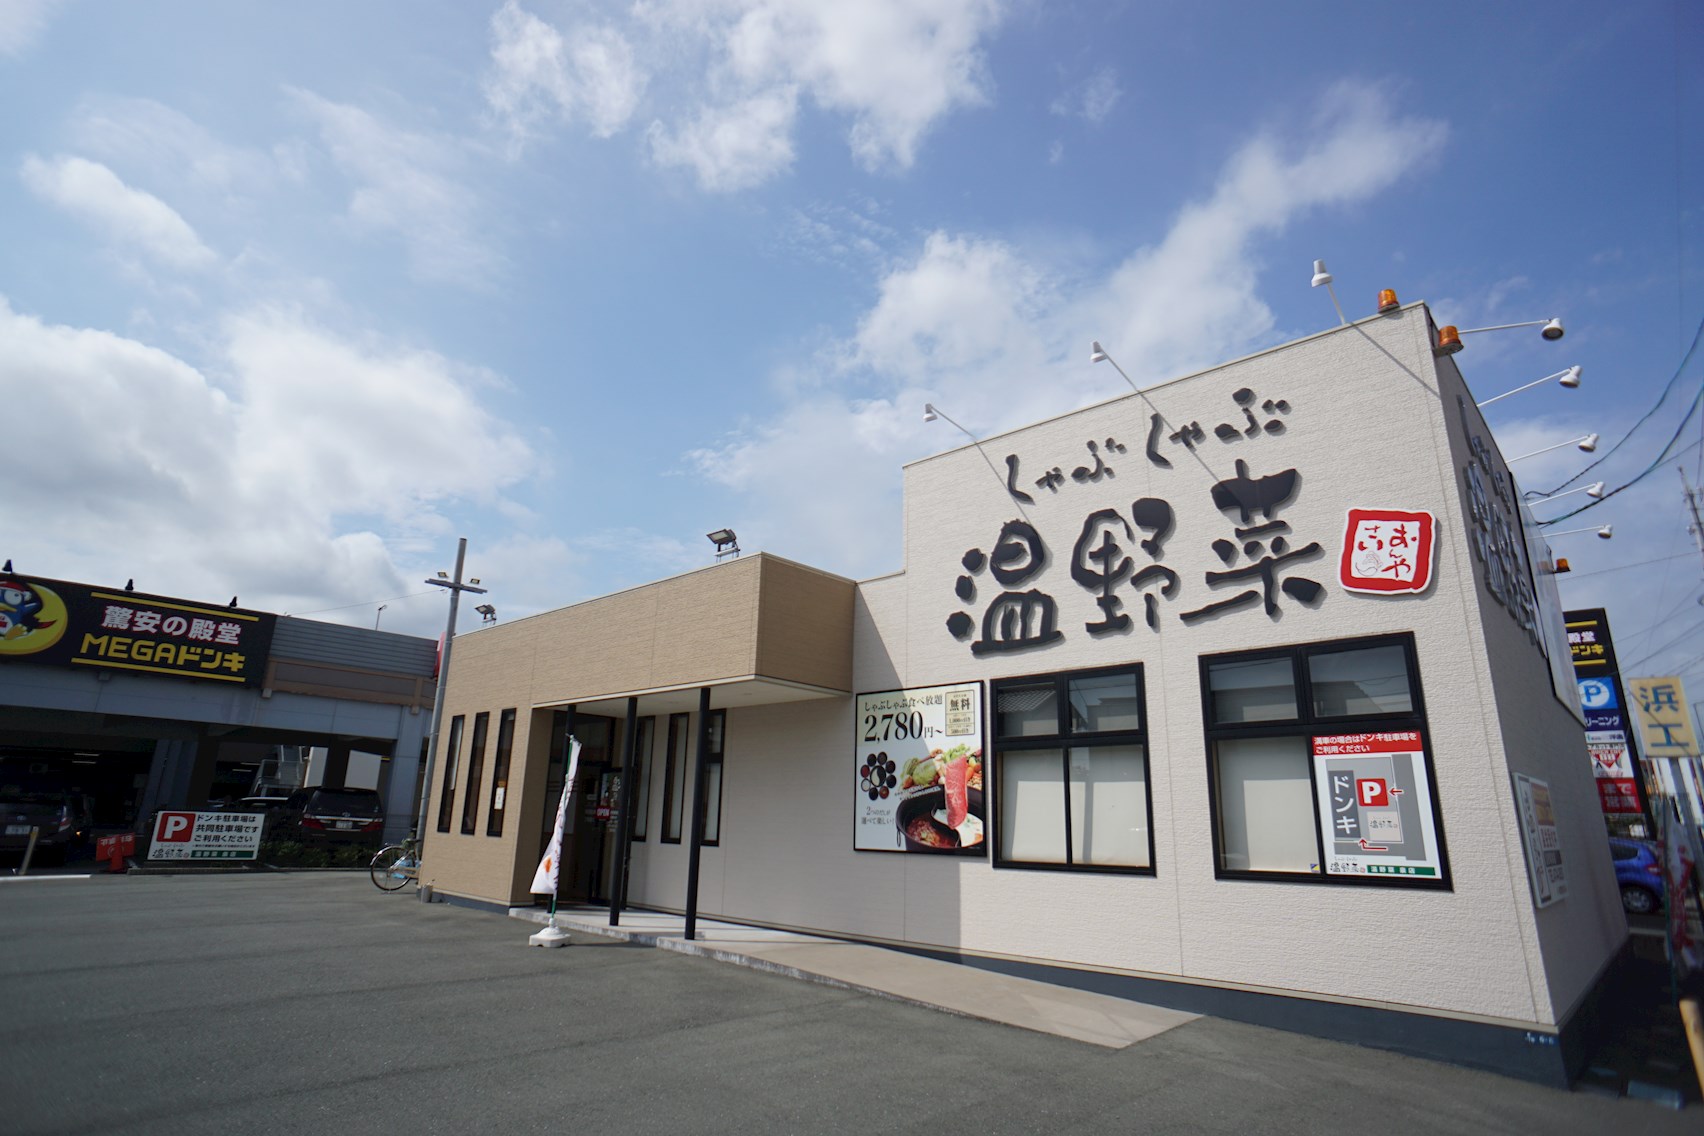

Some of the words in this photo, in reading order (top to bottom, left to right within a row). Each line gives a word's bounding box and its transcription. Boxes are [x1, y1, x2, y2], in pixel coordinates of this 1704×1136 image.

[1005, 387, 1291, 503] しゃぶしゃぶ
[1358, 525, 1383, 551] さい
[945, 458, 1325, 653] 温野菜
[1381, 523, 1417, 579] おんや
[101, 605, 242, 646] 驚安の殿堂
[80, 632, 246, 672] MEGAドンキ
[864, 694, 943, 712] しゃぶしゃぶ食べ放題
[949, 698, 971, 711] 無料
[1583, 684, 1602, 702] P
[1315, 745, 1371, 755] ご利用ください
[1361, 781, 1382, 804] P
[1333, 775, 1357, 834] ドンキ
[163, 815, 188, 839] P
[195, 824, 260, 833] 共同駐車場です
[196, 814, 257, 823] ドンキ駐車場は
[193, 834, 253, 843] ご利用ください
